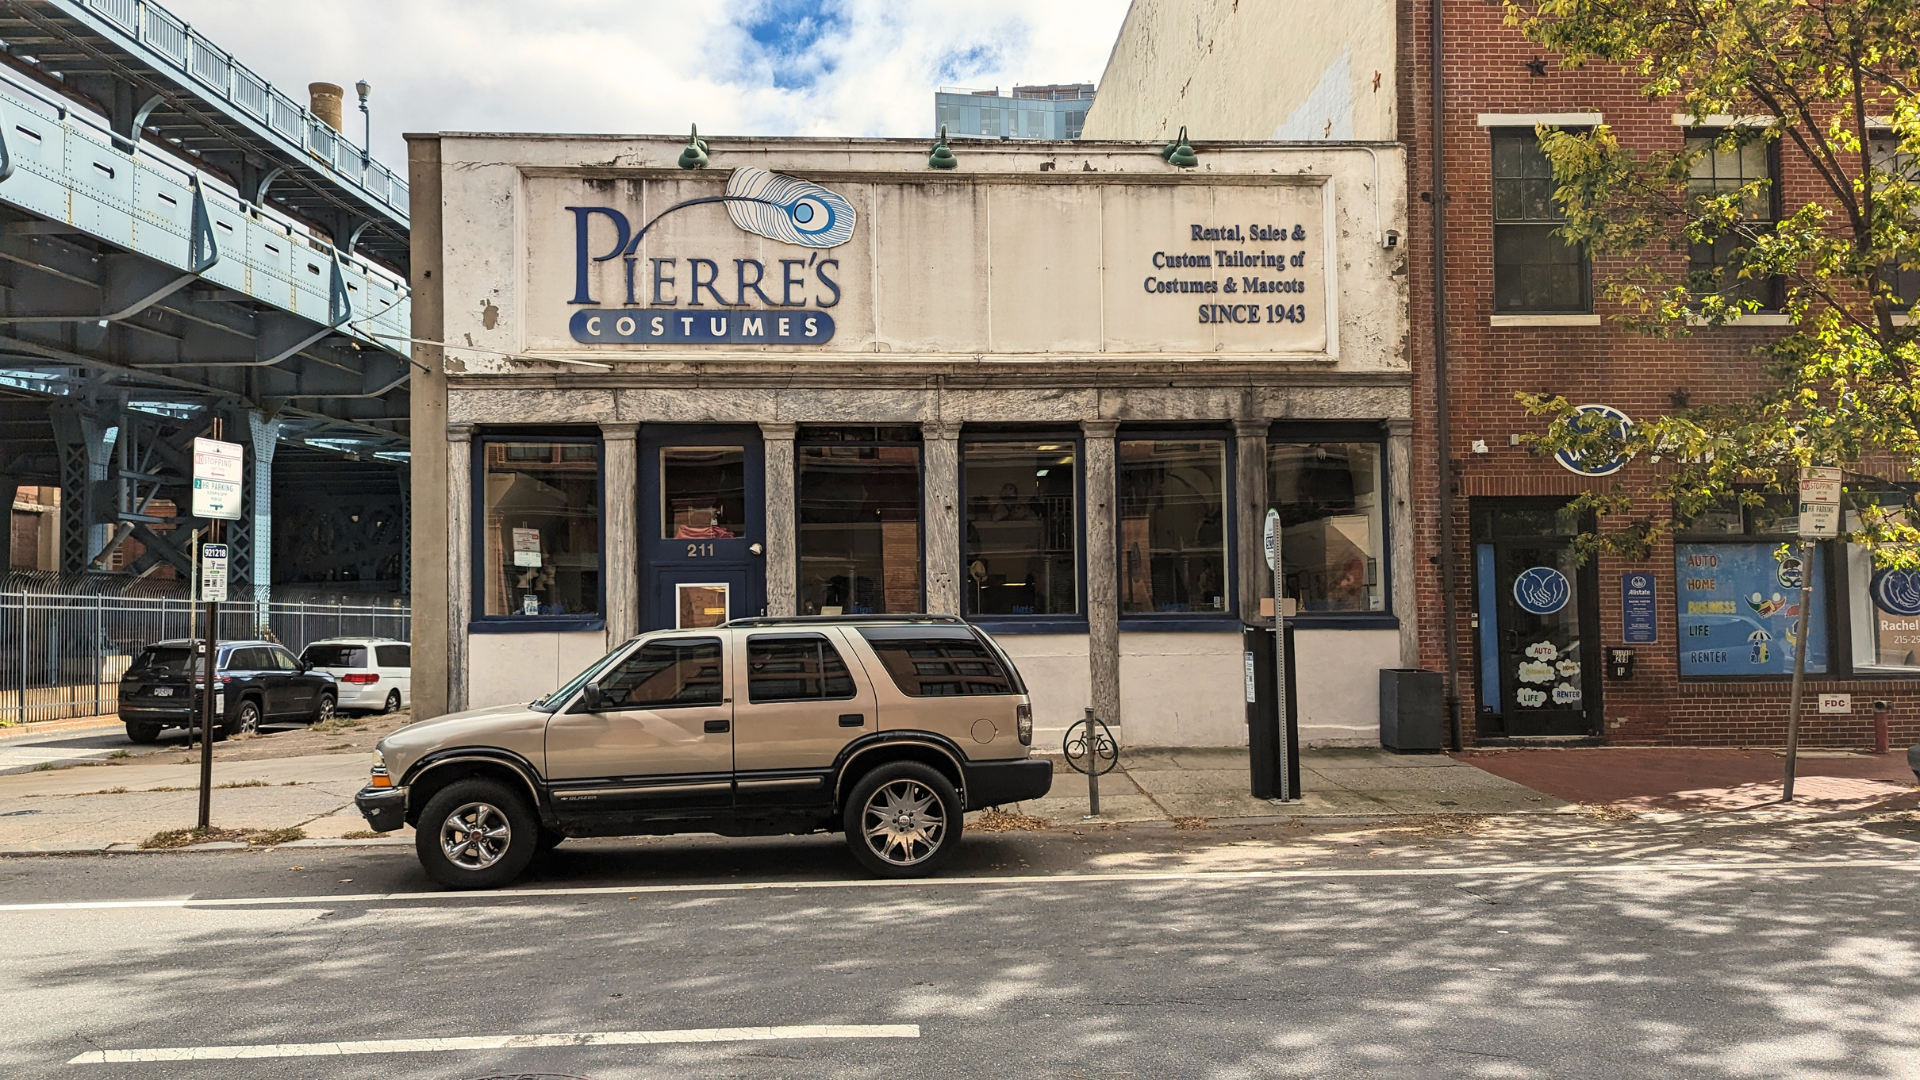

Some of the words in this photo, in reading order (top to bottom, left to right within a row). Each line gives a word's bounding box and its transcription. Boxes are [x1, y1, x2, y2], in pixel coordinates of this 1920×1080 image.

[1191, 224, 1246, 244] Rental,
[1249, 224, 1287, 241] Sales
[1291, 224, 1306, 241] &
[1152, 251, 1212, 269] Custom
[1215, 250, 1286, 271] Tailoring
[1290, 251, 1306, 267] of
[1144, 276, 1218, 294] Costumes
[1223, 277, 1237, 293] &
[1242, 276, 1305, 293] Mascots
[1198, 304, 1261, 323] SINCE
[1266, 304, 1306, 323] 1943
[586, 316, 819, 338] COSTUMES
[195, 454, 203, 464] NO
[204, 456, 232, 467] STOPPING
[203, 482, 210, 490] HR
[212, 482, 233, 492] PARKING
[1802, 482, 1810, 490] NO
[1810, 482, 1834, 491] STOPPING
[1816, 505, 1834, 514] PARKING
[204, 548, 227, 558] 921218
[687, 543, 714, 557] 211
[1687, 555, 1717, 567] AUTO
[1687, 579, 1716, 590] HOME
[1012, 604, 1035, 613] Hats
[1688, 601, 1737, 614] BUSINESS
[1689, 625, 1710, 636] LIFE
[1880, 619, 1919, 631] Rachel
[1534, 647, 1552, 655] AUTO
[1691, 652, 1728, 663] RENTER
[1523, 694, 1539, 702] LIFE
[1556, 690, 1580, 698] RENTER
[1824, 699, 1846, 707] FDC
